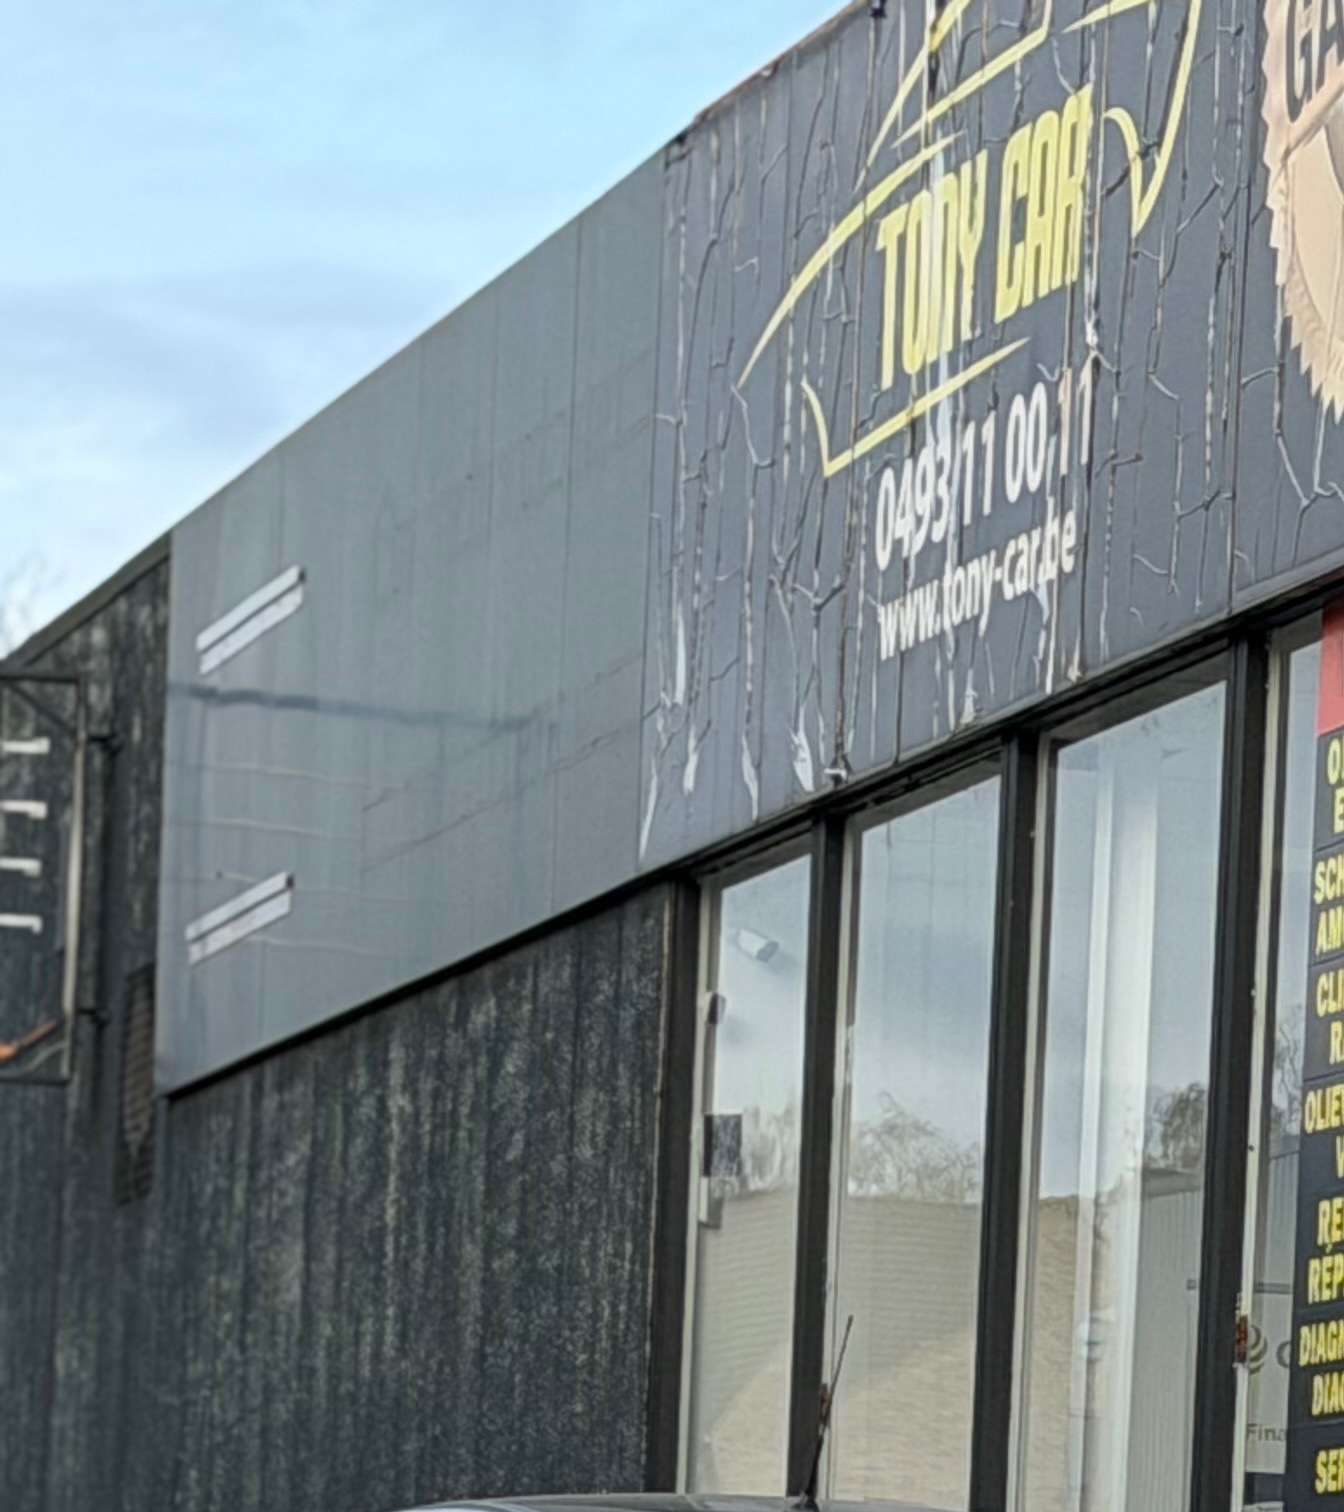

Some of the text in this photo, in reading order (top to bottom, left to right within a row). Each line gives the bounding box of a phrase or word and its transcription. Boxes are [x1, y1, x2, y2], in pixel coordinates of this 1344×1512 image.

[876, 83, 1093, 391] TONY CAR
[1005, 381, 1048, 502] 00
